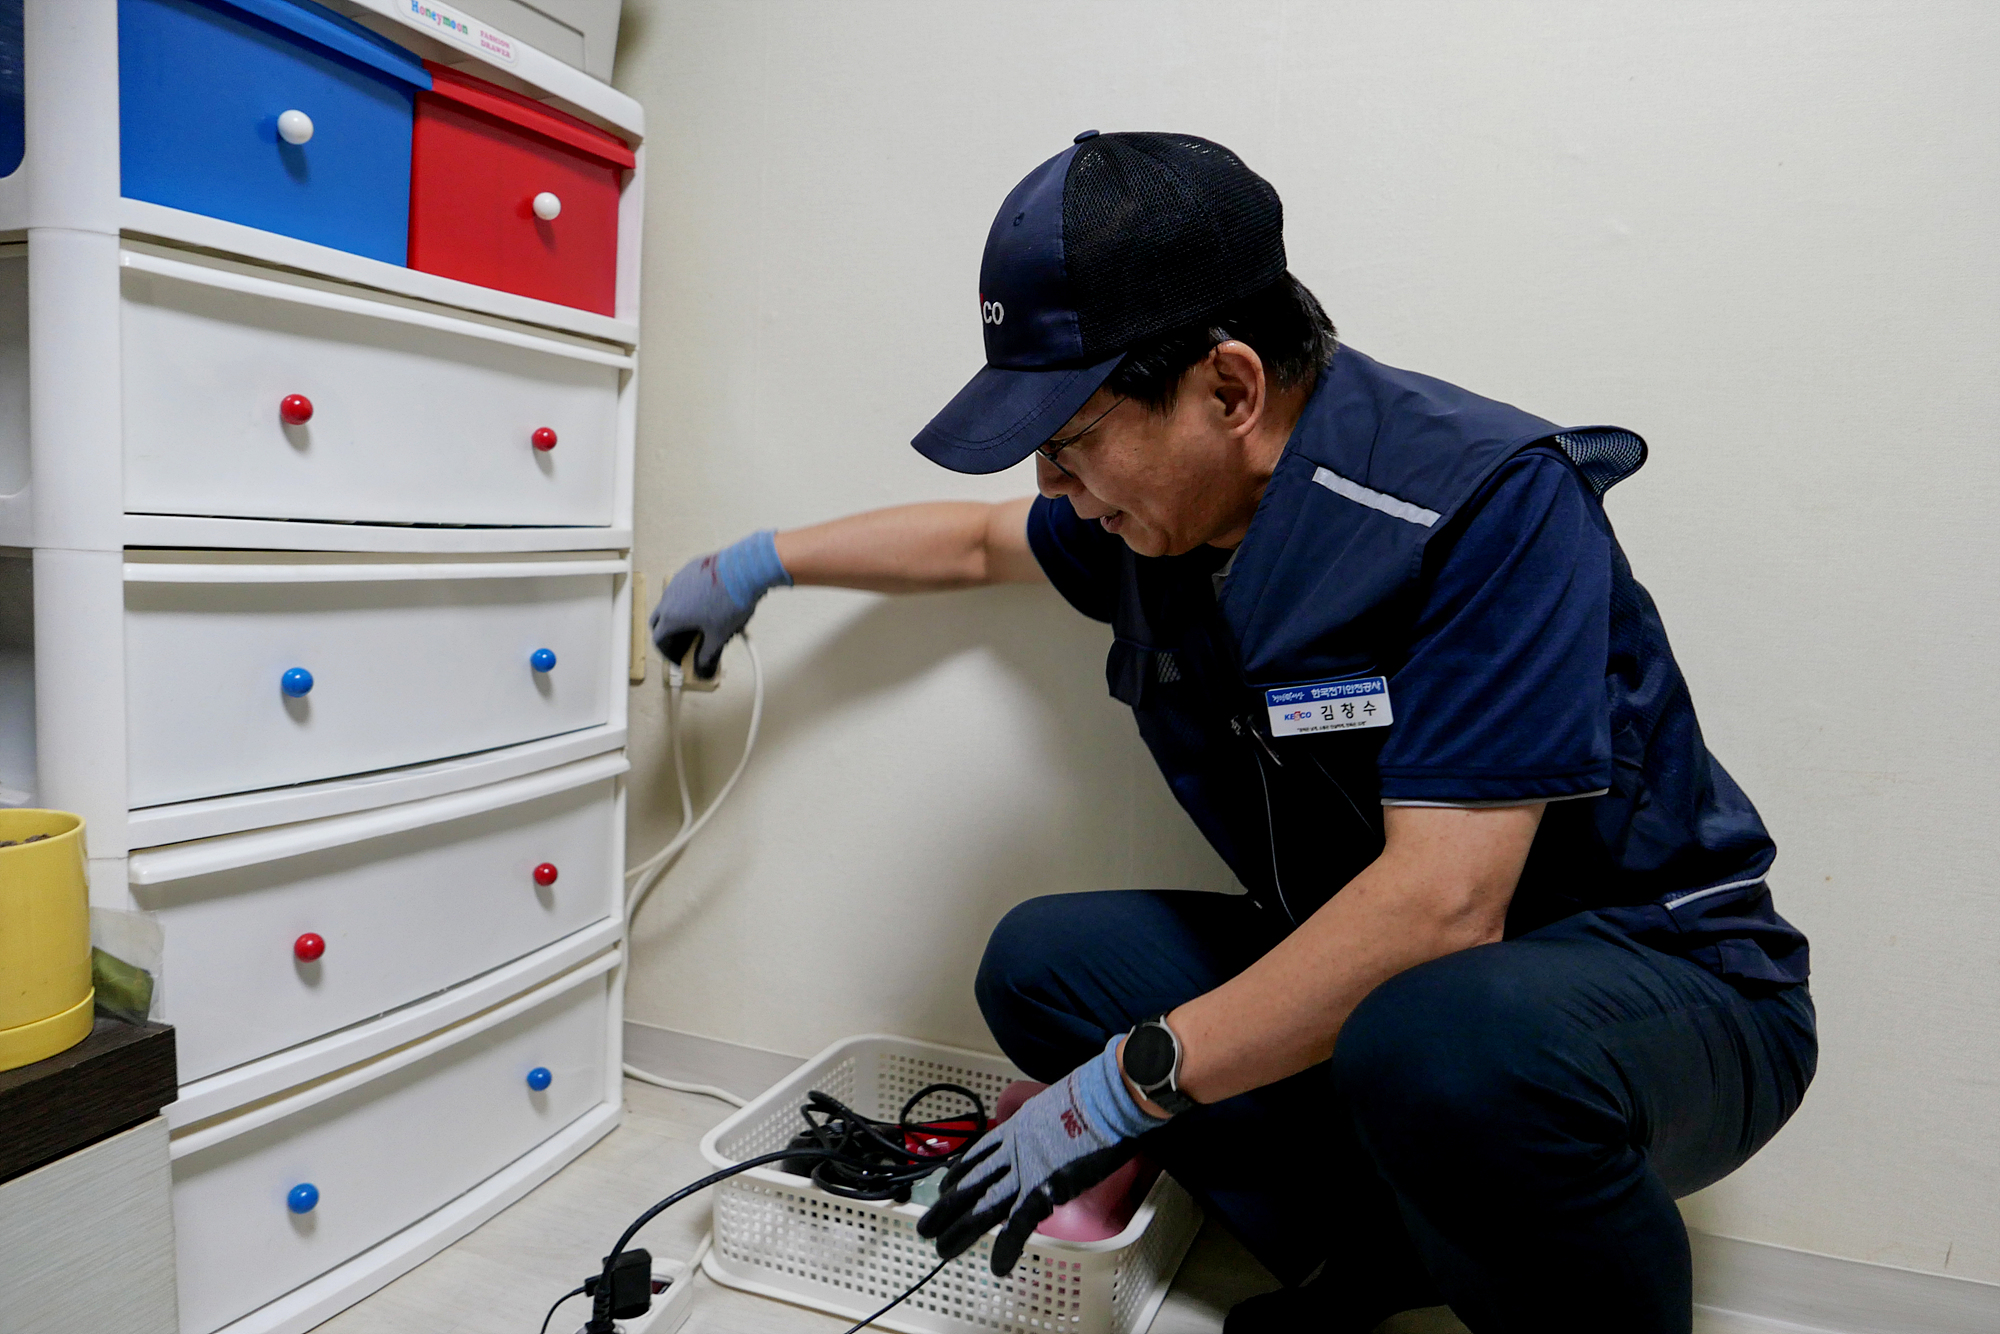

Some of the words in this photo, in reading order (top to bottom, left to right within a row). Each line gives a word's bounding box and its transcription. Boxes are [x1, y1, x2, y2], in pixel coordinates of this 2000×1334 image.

[411, 0, 468, 34] Honeymoon
[981, 296, 1005, 325] CO
[1310, 680, 1382, 699] 한국전기안전공사
[1284, 710, 1312, 722] KESCO
